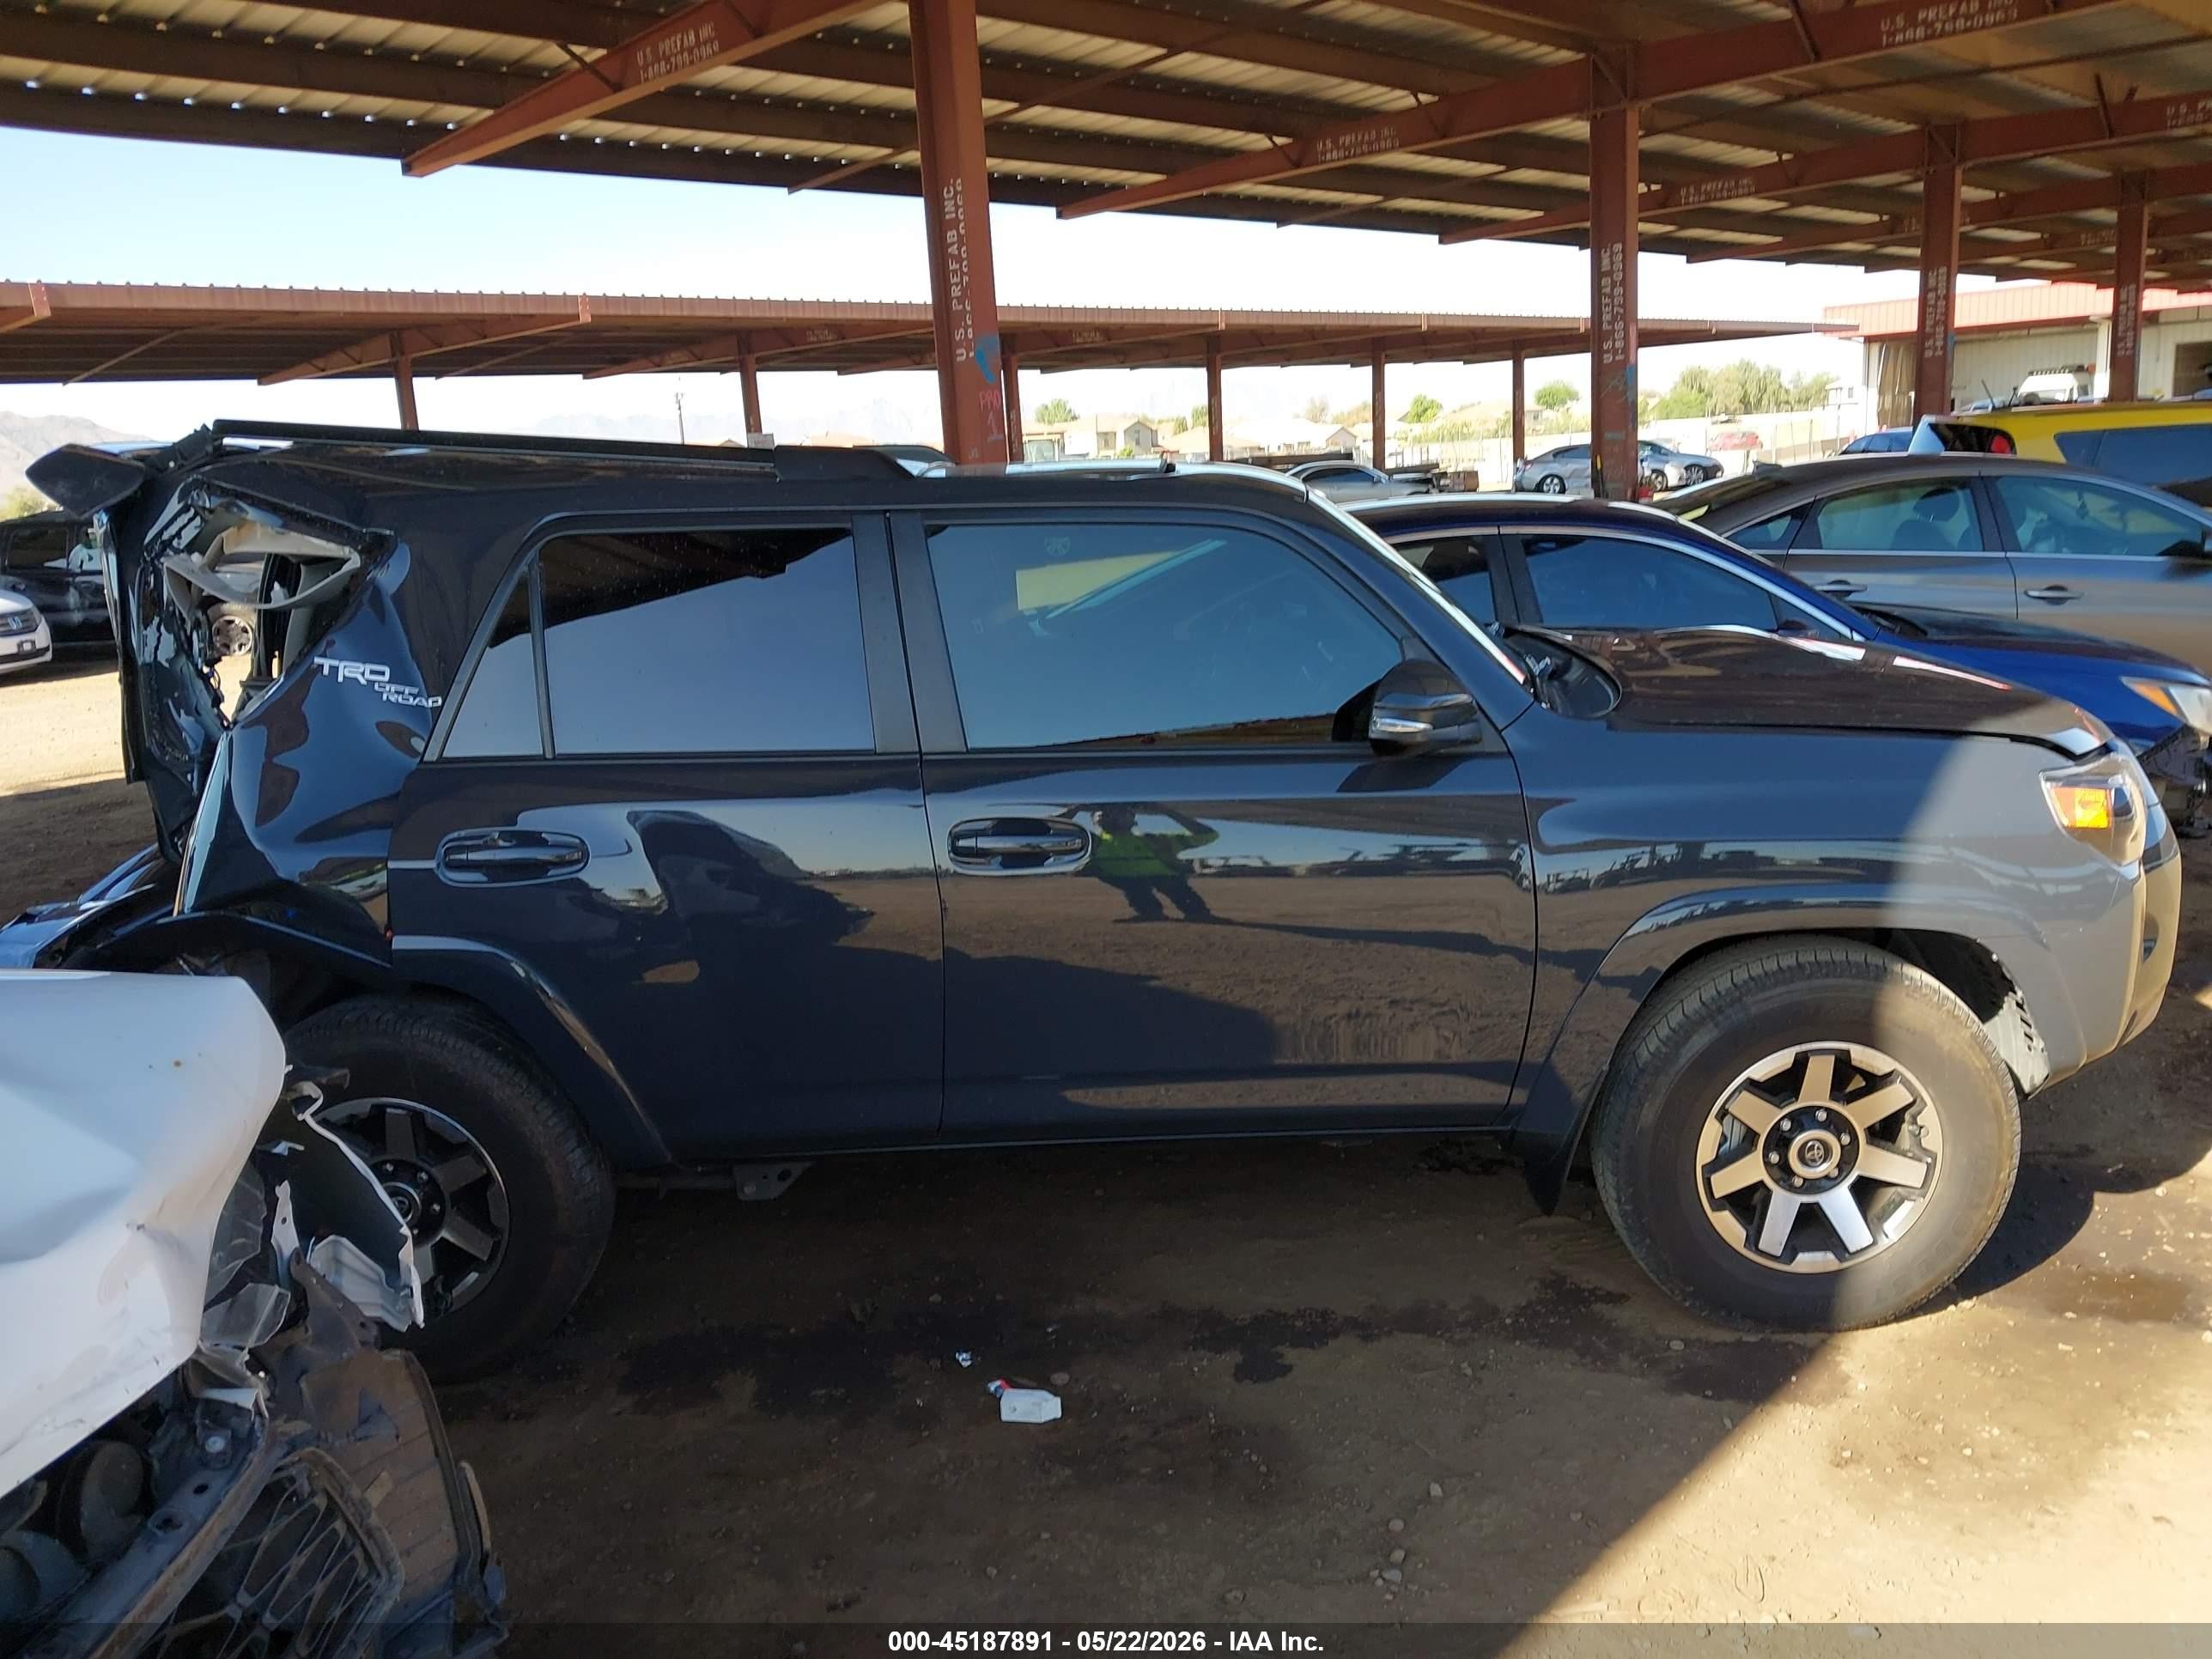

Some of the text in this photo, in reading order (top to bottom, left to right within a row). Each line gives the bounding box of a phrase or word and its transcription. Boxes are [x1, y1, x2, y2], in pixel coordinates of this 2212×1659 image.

[943, 177, 967, 362] U.S. PREFAB INC.
[1601, 275, 1613, 331] PREFAB
[313, 656, 391, 685] TRD
[382, 692, 442, 708] ROAD
